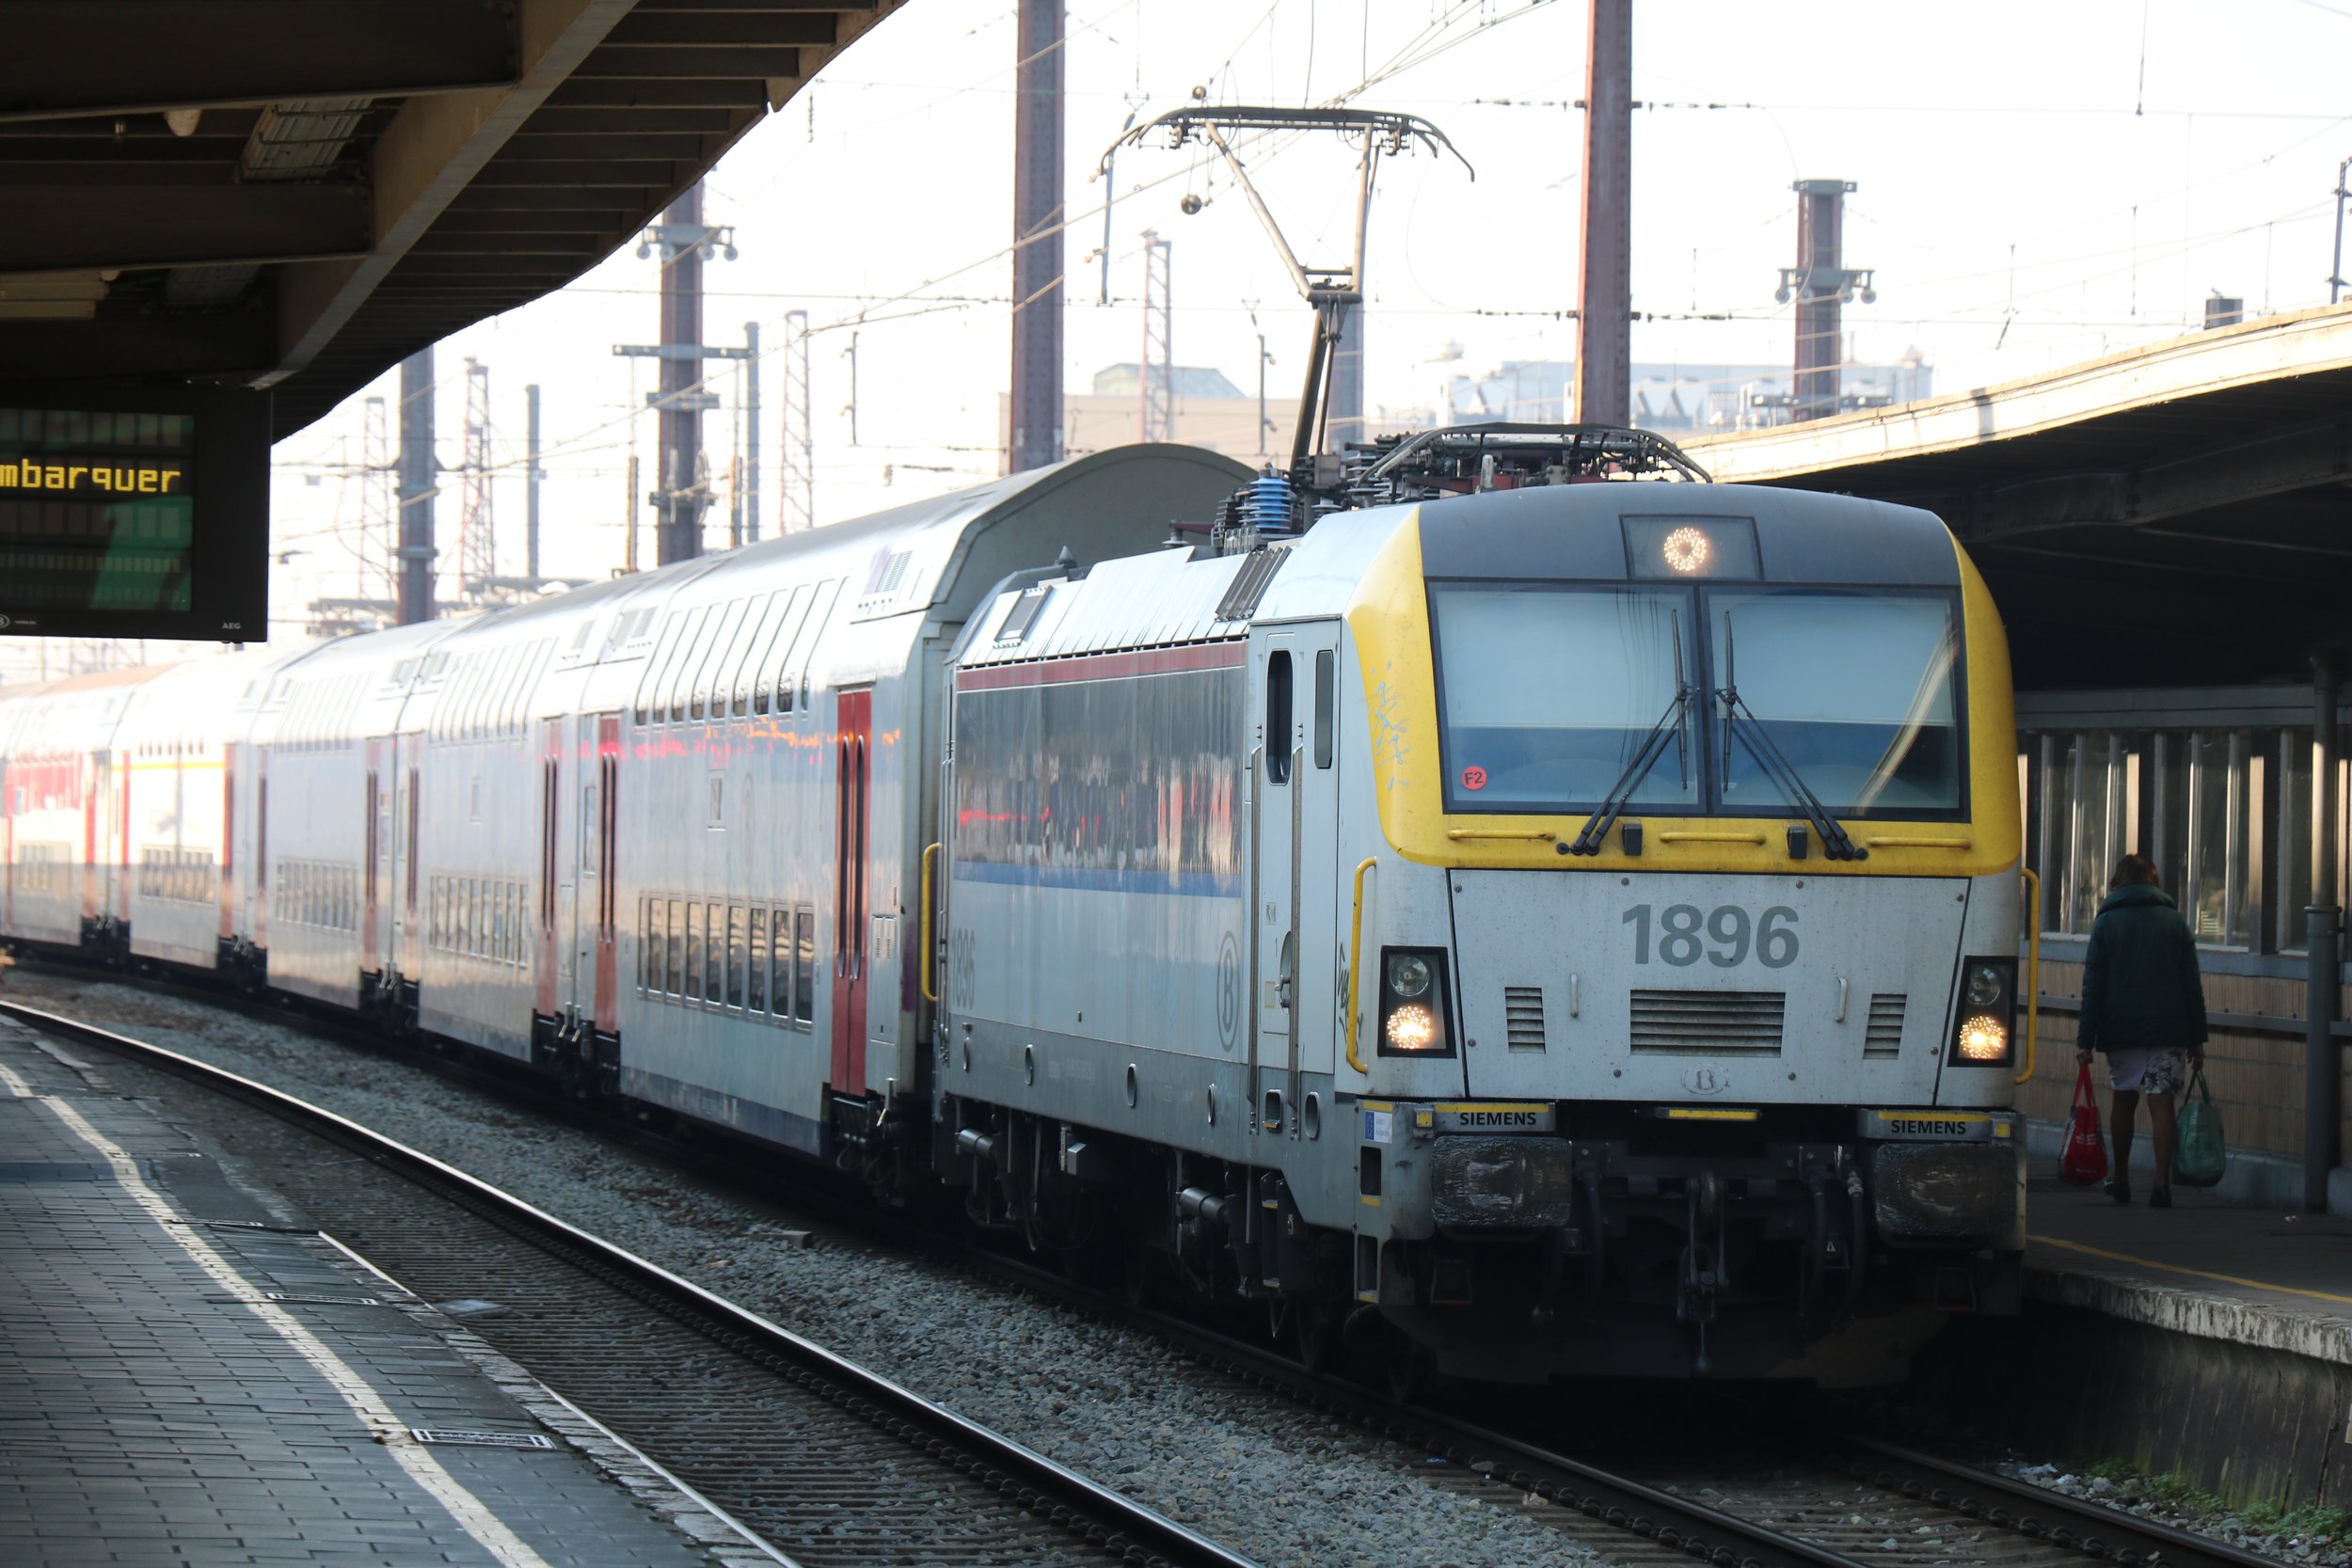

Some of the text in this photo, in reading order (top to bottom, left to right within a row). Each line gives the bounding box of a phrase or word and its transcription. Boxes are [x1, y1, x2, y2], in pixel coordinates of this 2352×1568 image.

[1464, 771, 1484, 784] F2
[1622, 903, 1800, 969] 1896
[952, 927, 976, 1009] 1896
[1459, 1112, 1537, 1126] SIEMENS
[1891, 1119, 1967, 1134] SIEMENS
